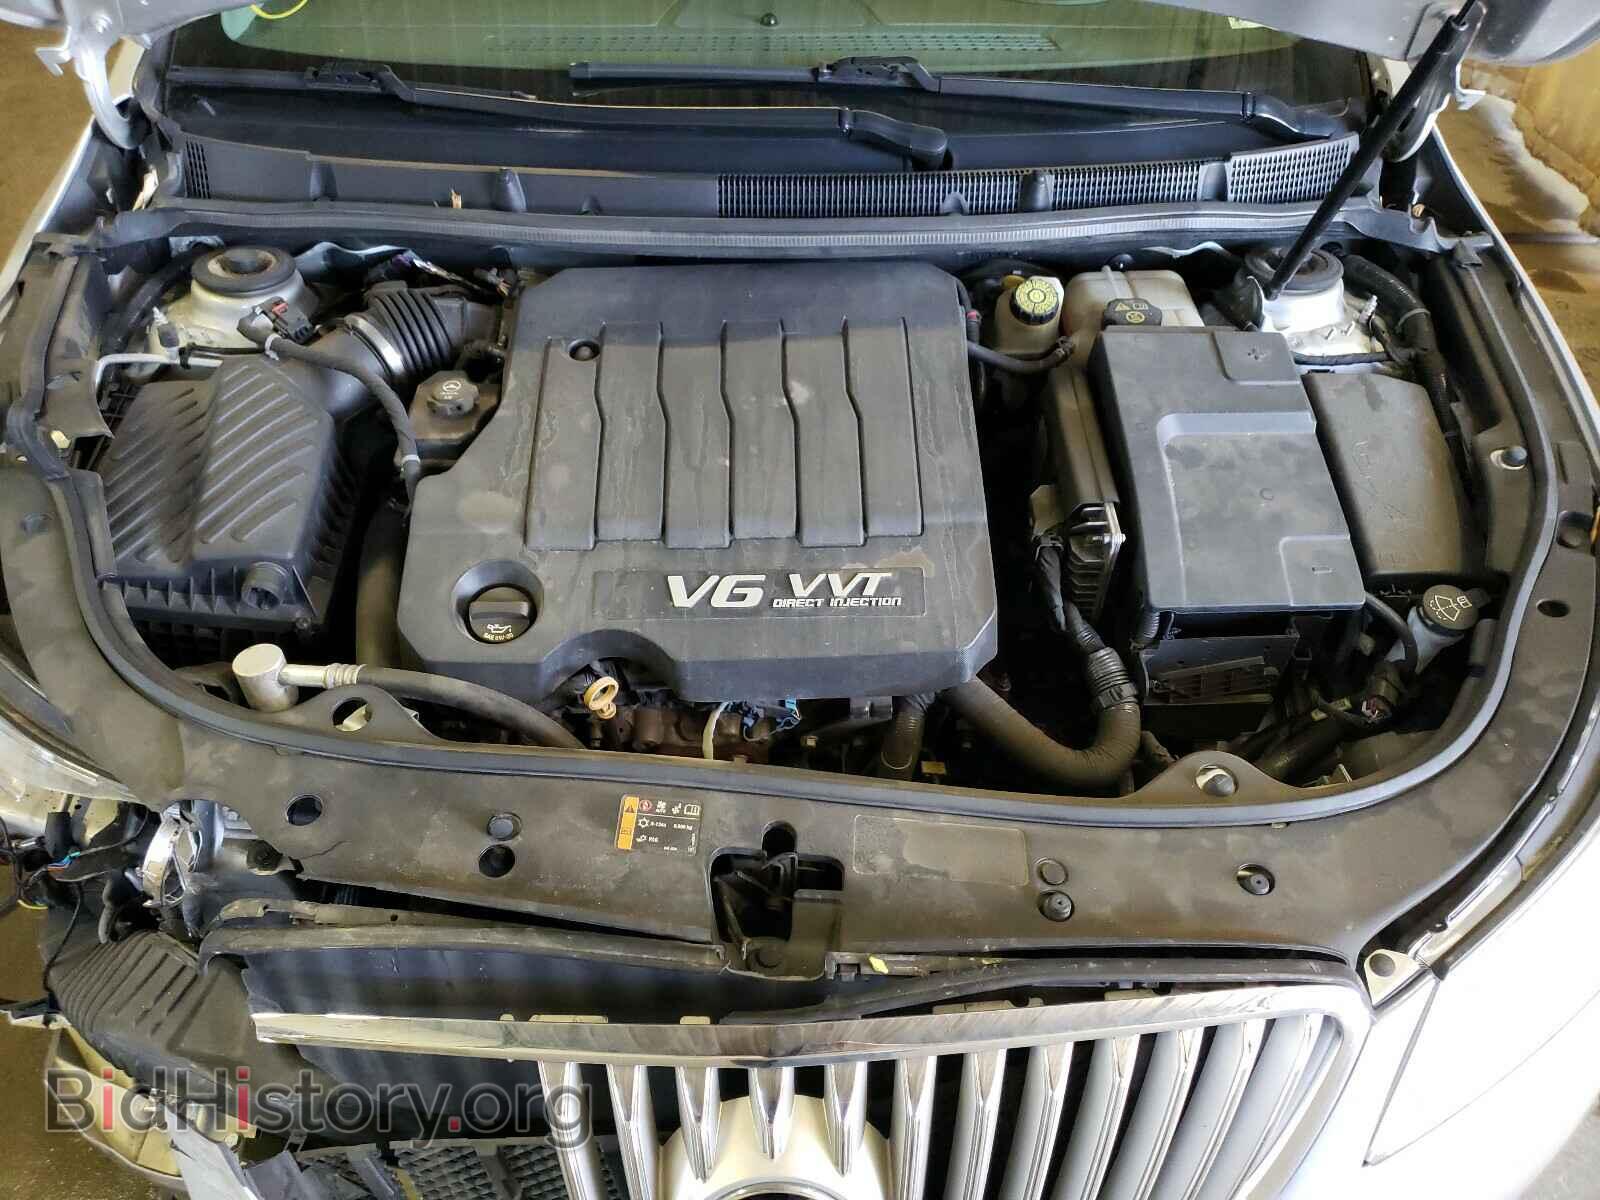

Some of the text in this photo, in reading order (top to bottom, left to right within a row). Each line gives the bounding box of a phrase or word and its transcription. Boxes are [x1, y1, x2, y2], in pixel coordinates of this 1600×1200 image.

[667, 572, 893, 608] V6 VVT
[772, 597, 902, 609] DIRECT INJECTION
